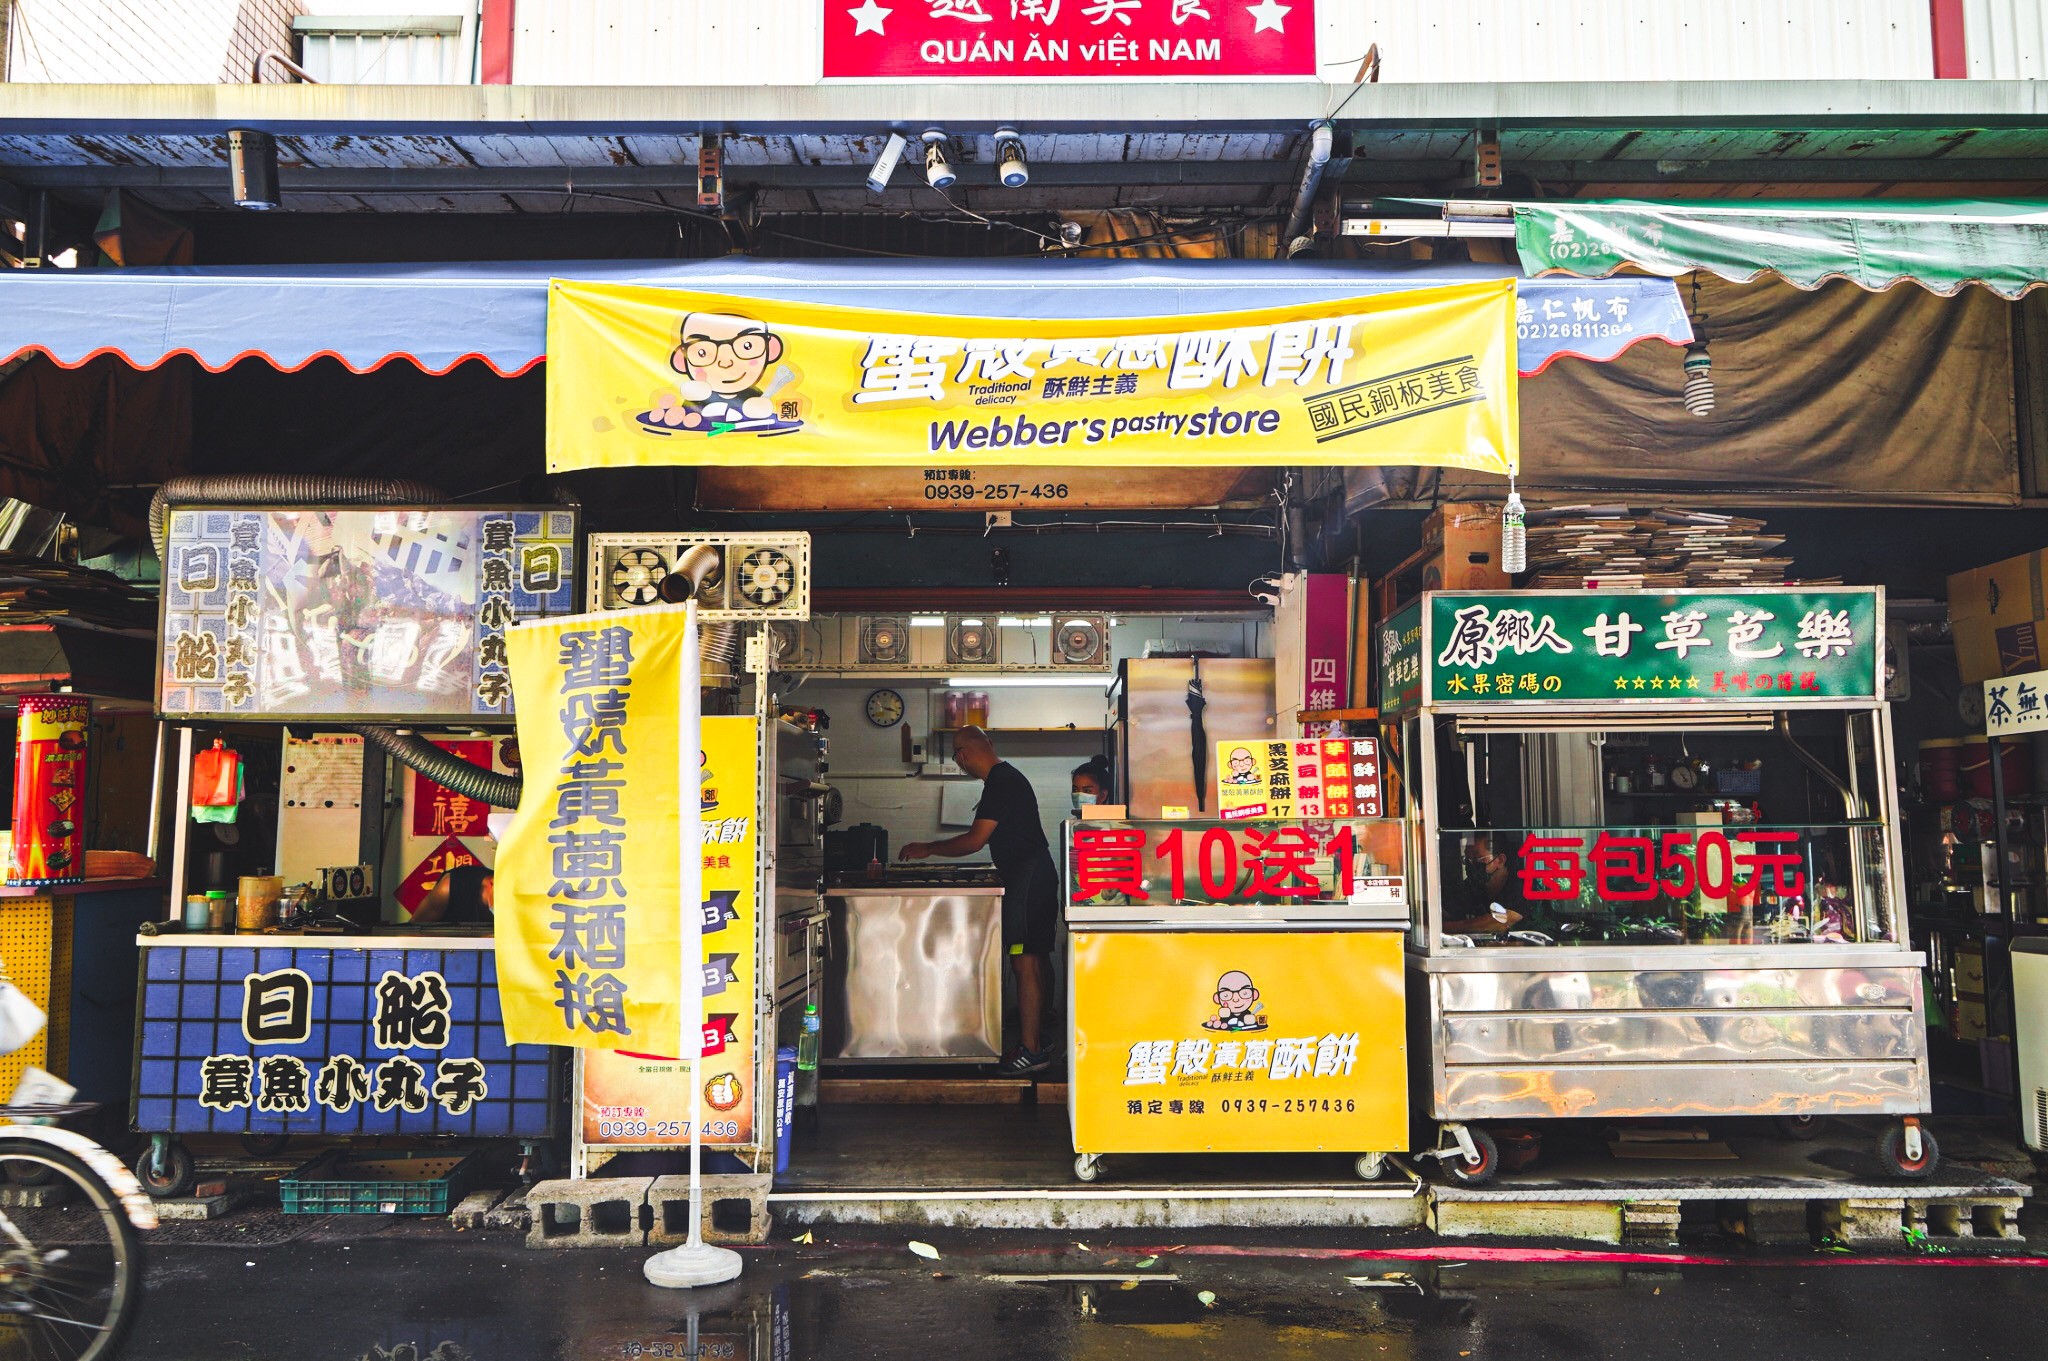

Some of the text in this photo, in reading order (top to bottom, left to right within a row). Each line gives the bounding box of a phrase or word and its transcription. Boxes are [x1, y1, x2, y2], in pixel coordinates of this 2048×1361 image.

[921, 33, 1014, 64] QUÁN
[1023, 34, 1070, 61] ĂN
[1149, 39, 1221, 61] NAM
[968, 379, 1032, 396] Traditional
[1042, 373, 1139, 399] 酥鮮主義
[975, 394, 1018, 406] delicacy
[1307, 364, 1482, 433] 國民銅板美食
[930, 405, 1281, 452] Webber's pastry store
[924, 484, 1069, 500] 0939-257-436
[1582, 610, 1857, 660] 甘草芭樂
[1447, 672, 1562, 695] 水果密碼の
[1310, 658, 1336, 736] 四維
[1987, 681, 2048, 728] 茶無
[1272, 805, 1291, 817] 17
[1300, 804, 1319, 815] 13
[1329, 803, 1349, 815] 13
[1357, 802, 1377, 815] 13
[1071, 826, 1355, 901] 買10送1
[1517, 830, 1806, 901] 每包50元
[1176, 1073, 1208, 1082] Traditional
[1210, 1071, 1255, 1083] 酥鮮主義
[1126, 1099, 1205, 1115] 預定專線
